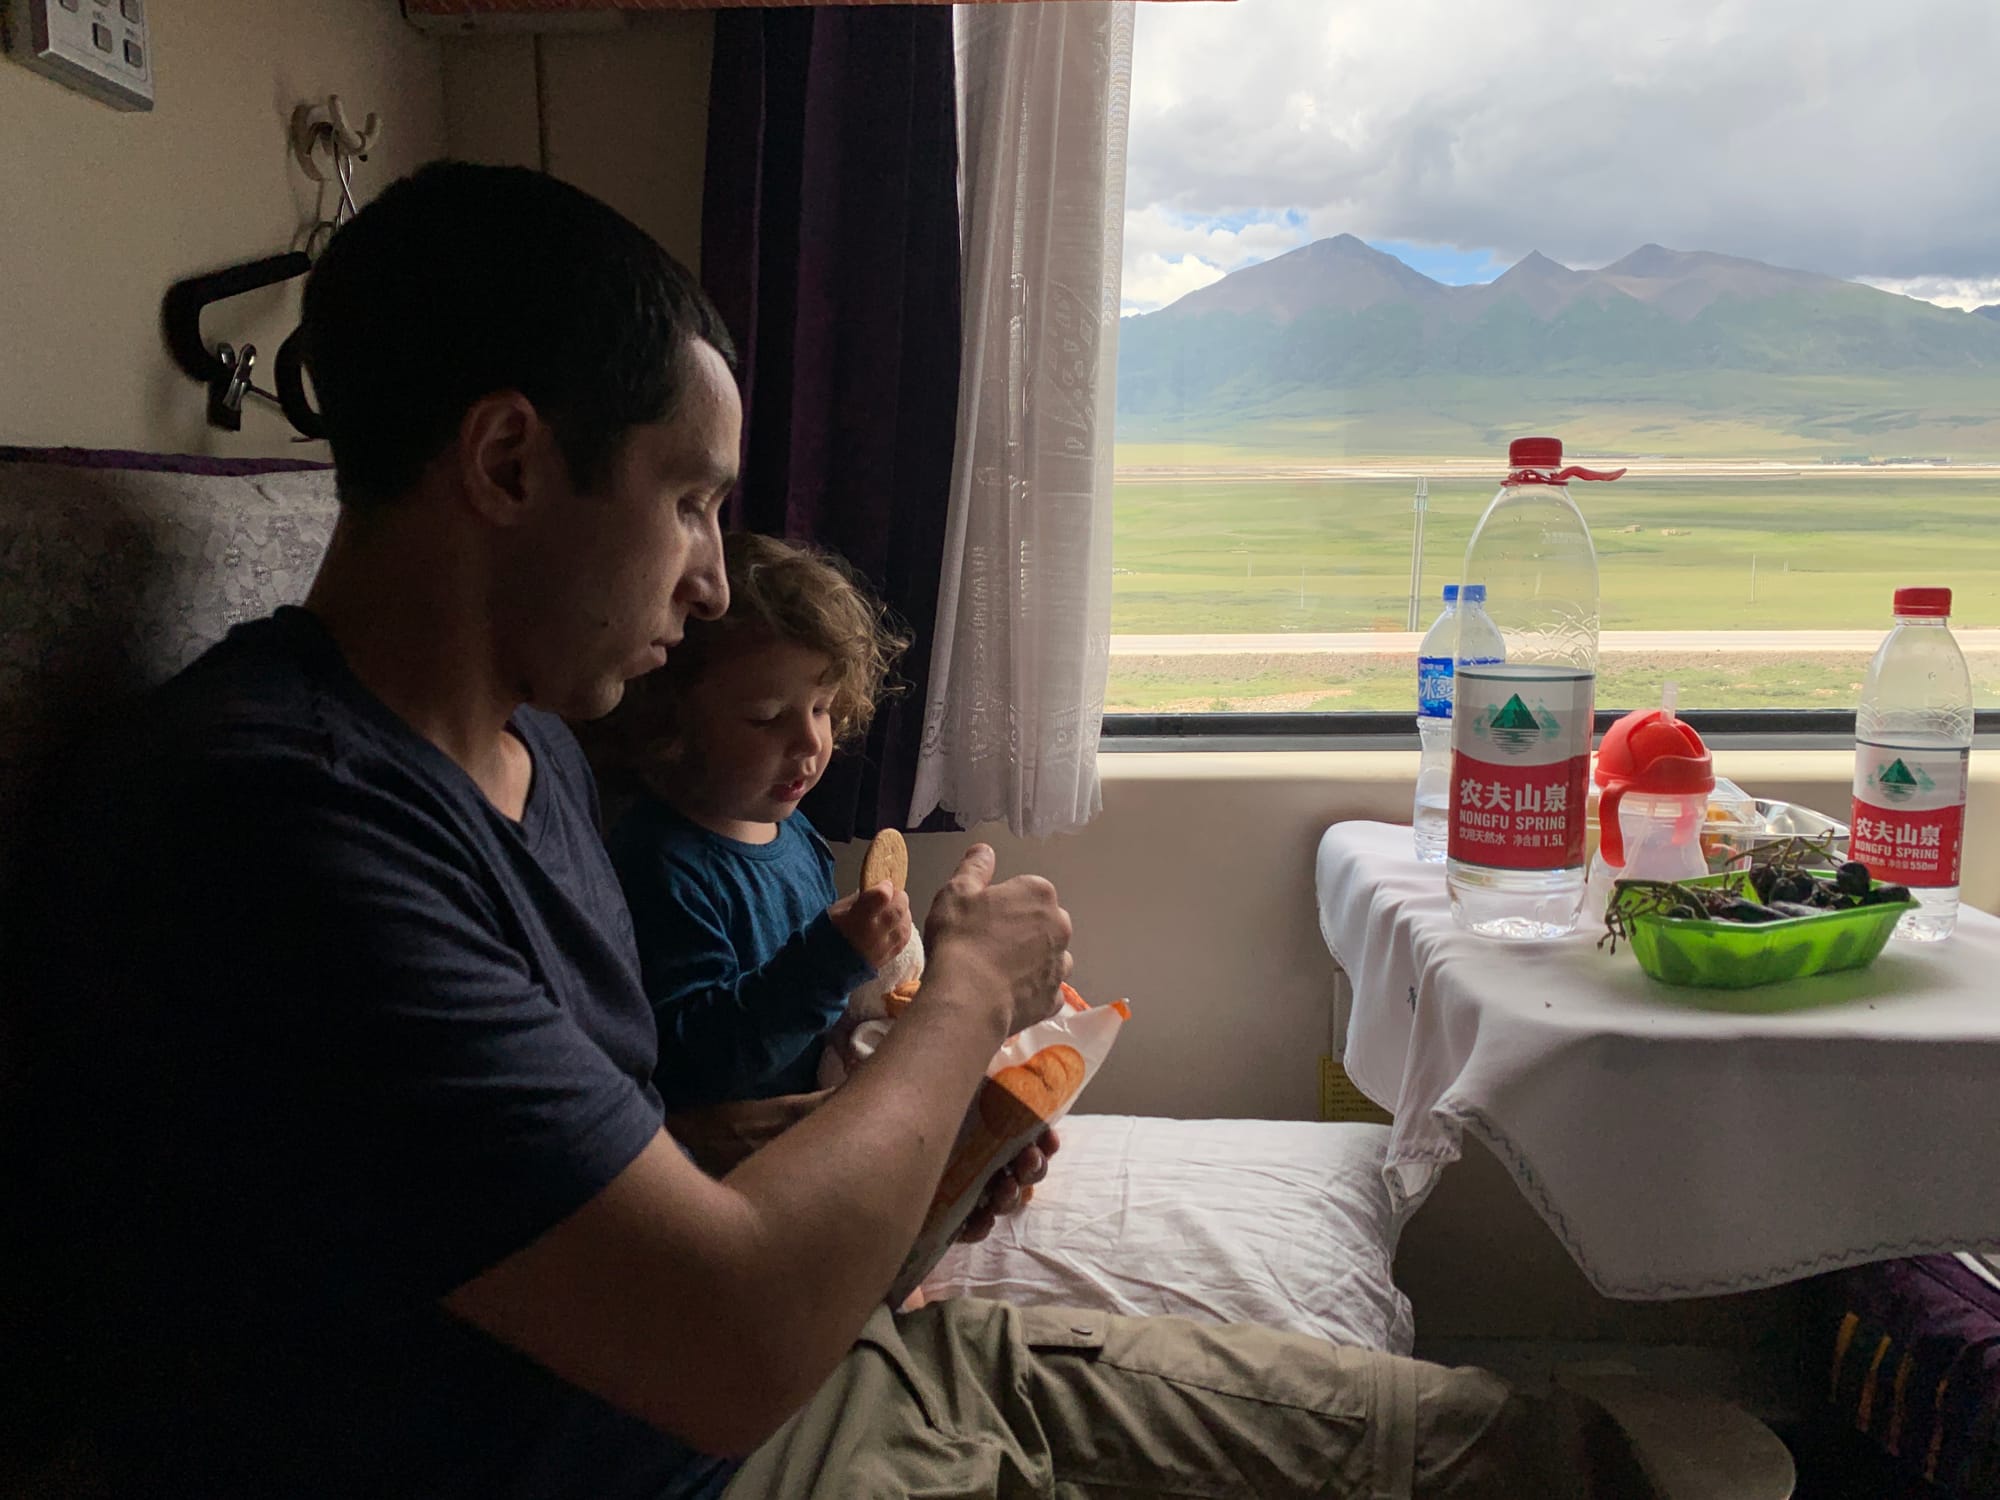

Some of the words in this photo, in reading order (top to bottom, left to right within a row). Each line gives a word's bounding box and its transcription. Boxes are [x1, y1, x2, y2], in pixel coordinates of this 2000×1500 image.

[1460, 778, 1567, 813] 农夫山泉
[1459, 809, 1509, 829] NONGFU
[1515, 815, 1566, 831] SPRING
[1543, 833, 1565, 847] 1.5L
[1856, 817, 1940, 846] 农夫山泉
[1855, 839, 1892, 856] NONGFU
[1896, 847, 1939, 860] SPRING
